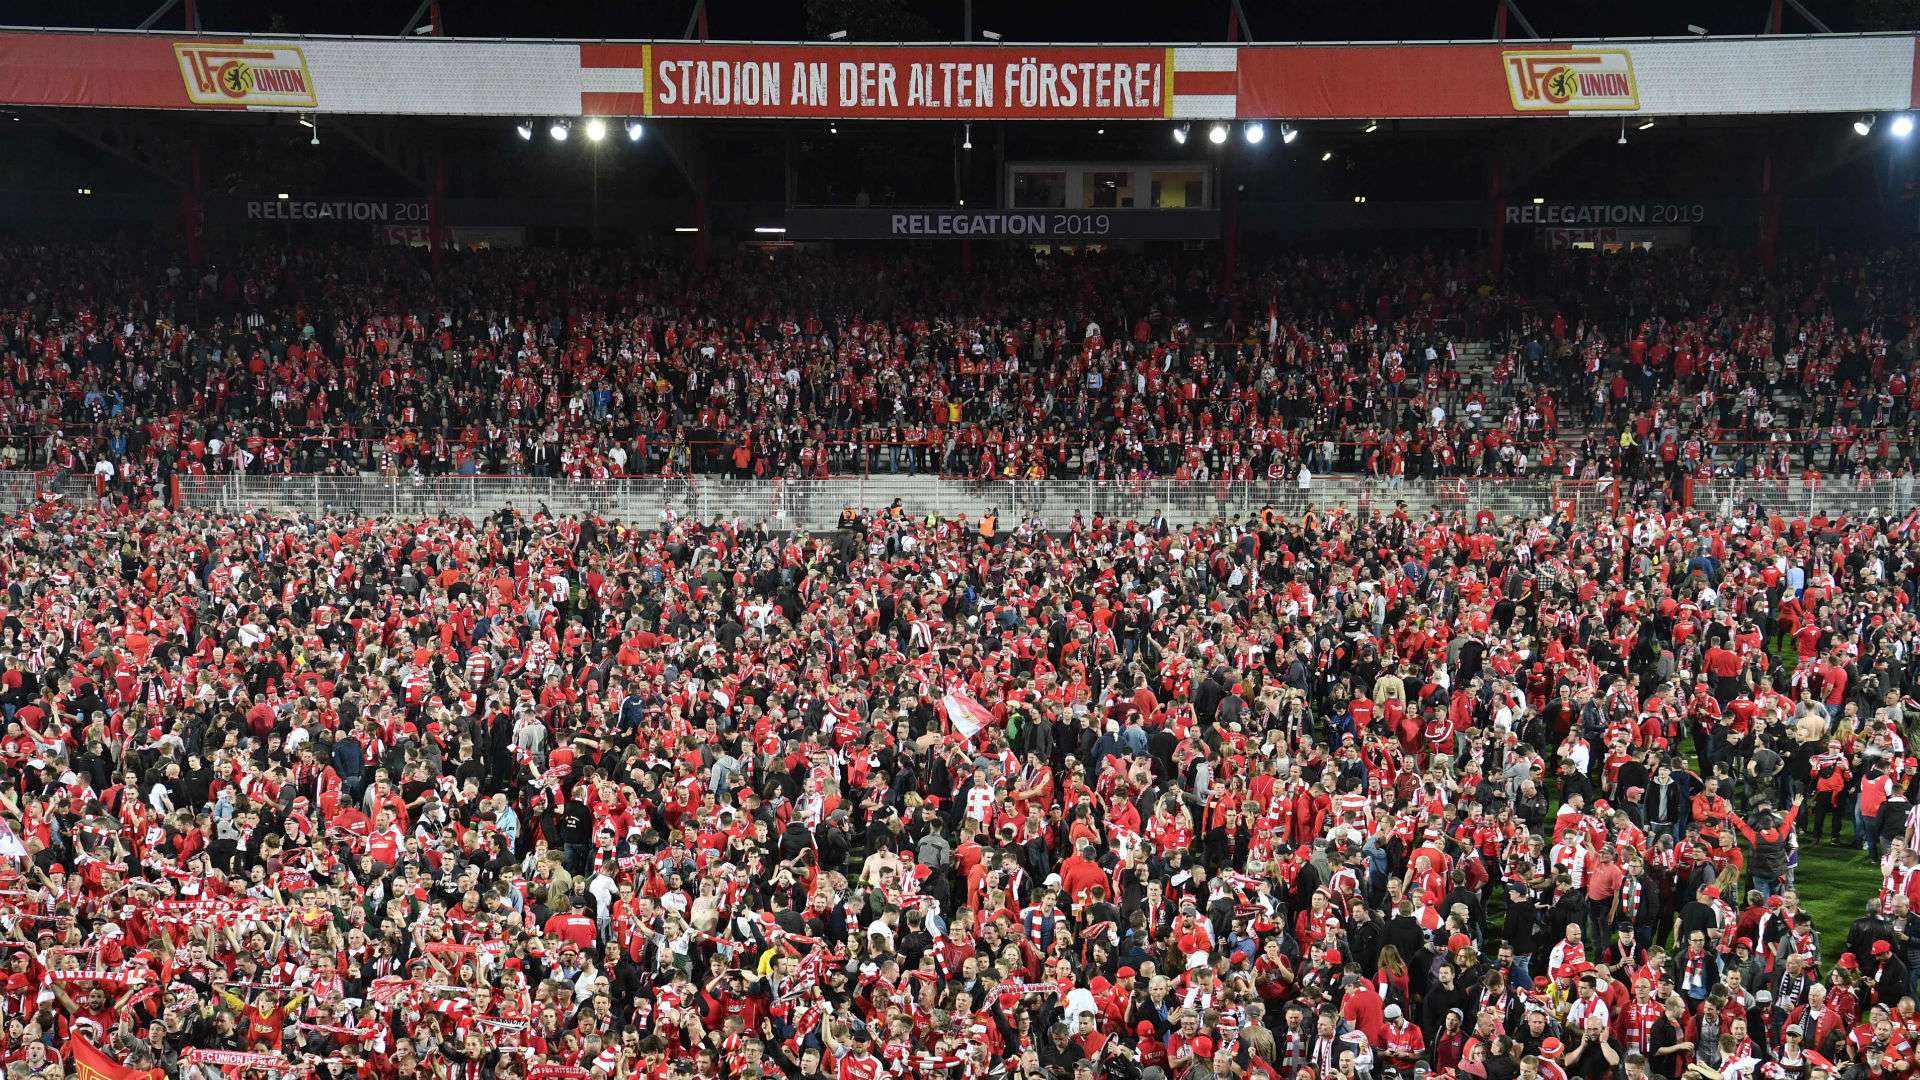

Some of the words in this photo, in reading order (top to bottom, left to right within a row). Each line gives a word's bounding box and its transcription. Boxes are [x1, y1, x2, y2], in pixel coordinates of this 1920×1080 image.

[253, 68, 306, 92] UNION
[659, 60, 781, 106] STADION
[791, 62, 828, 106] AN
[839, 62, 899, 107] DER
[907, 63, 994, 107] ALTEN
[1004, 57, 1162, 107] FÖRSTEREI
[1578, 73, 1630, 96] UNION
[247, 201, 388, 221] RELEGATION
[393, 202, 432, 222] 201
[1504, 205, 1646, 223] RELEGATION
[1651, 205, 1705, 223] 2019
[891, 215, 1046, 235] RELEGATION
[1053, 215, 1110, 235] 2019
[214, 1053, 243, 1064] UNION
